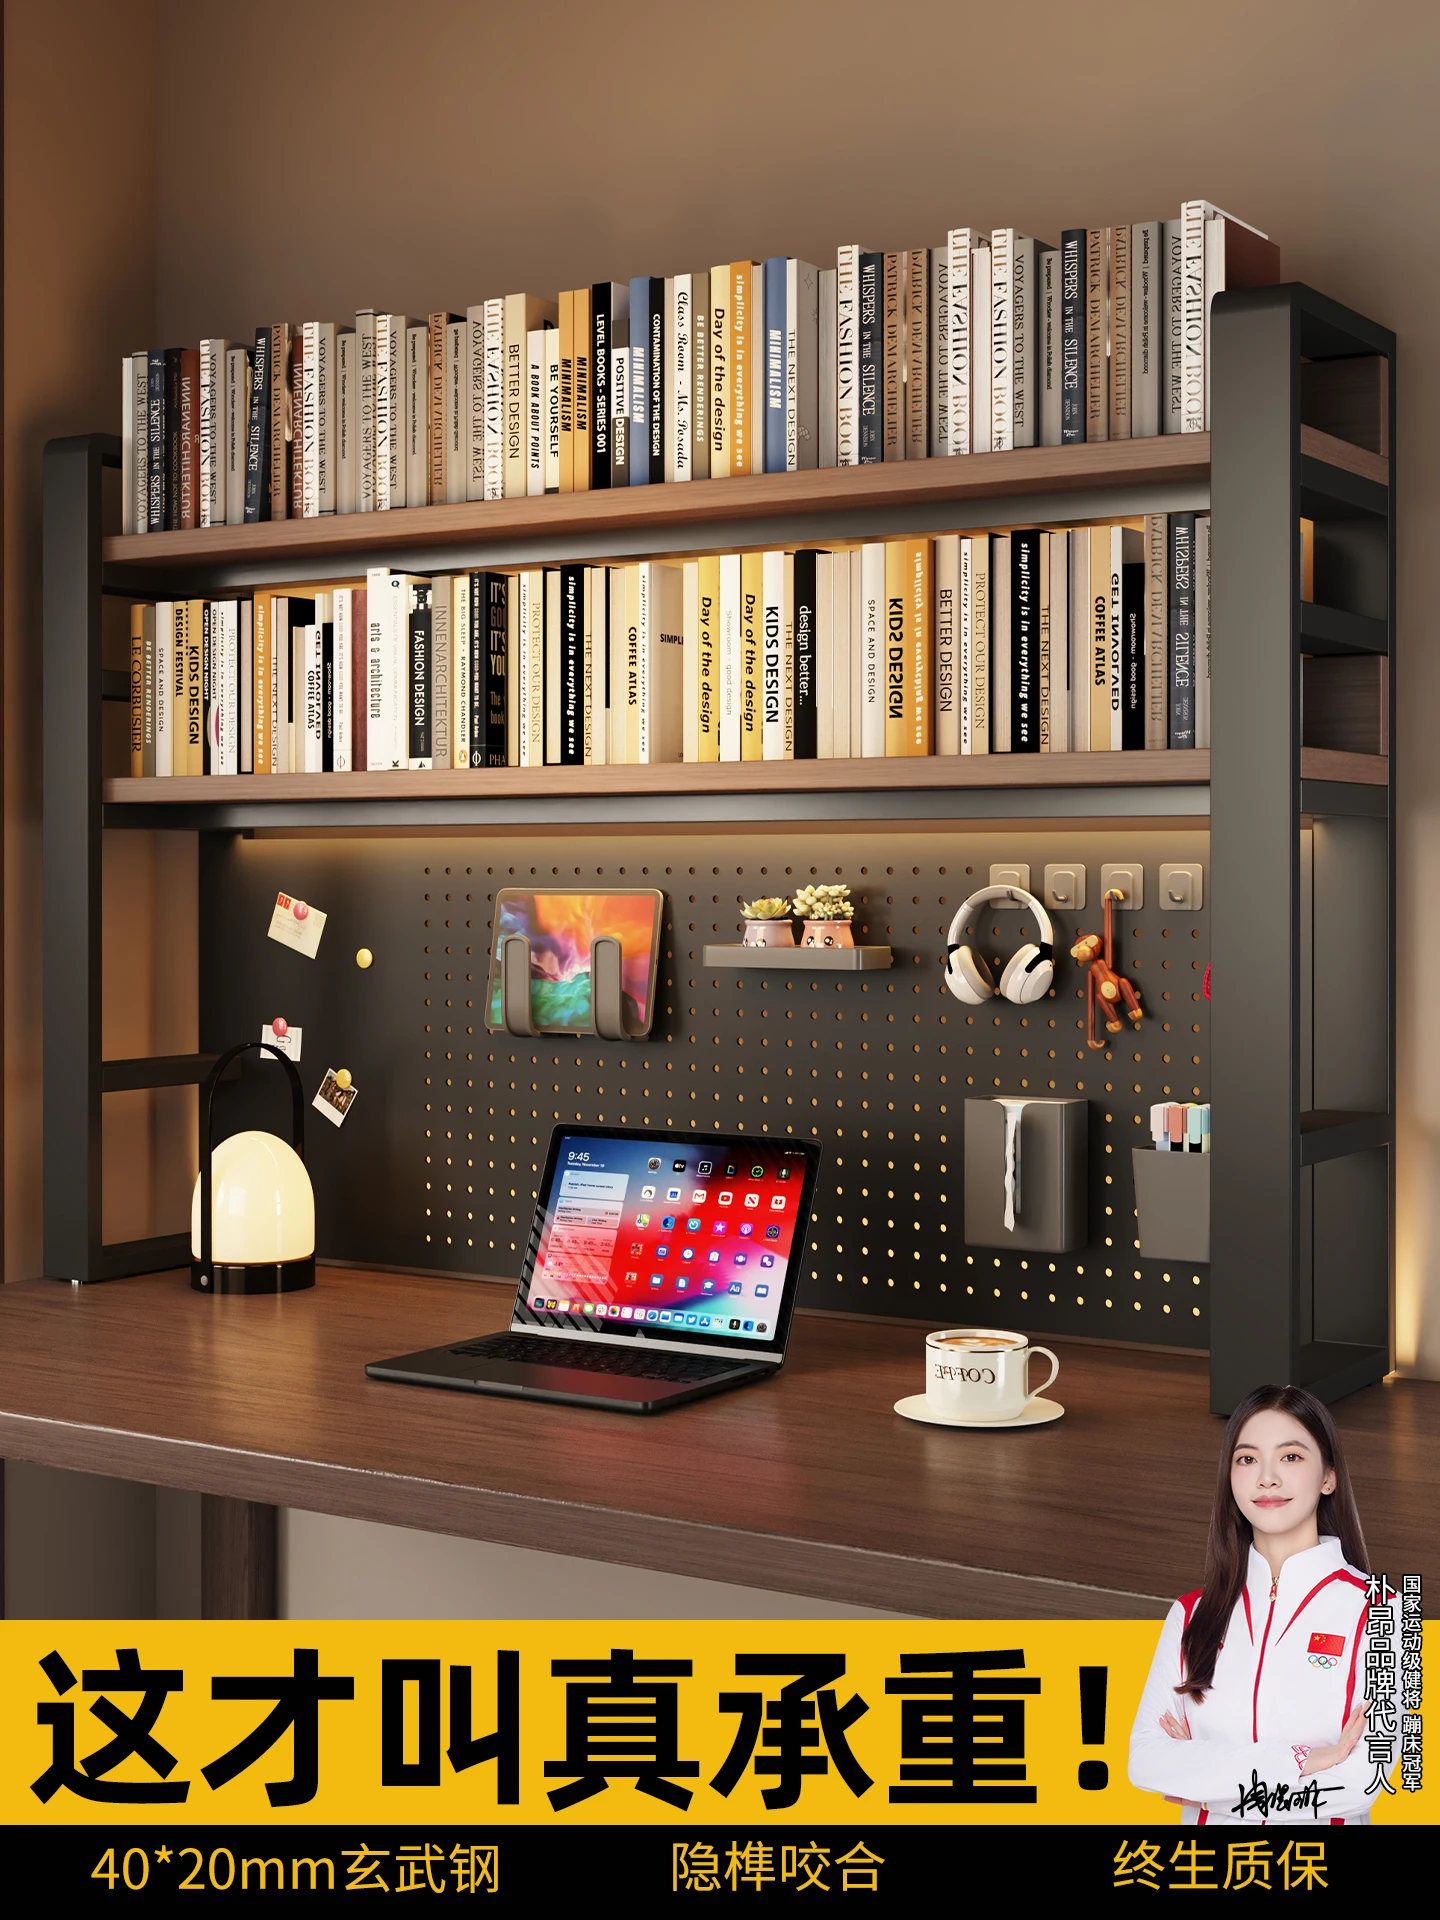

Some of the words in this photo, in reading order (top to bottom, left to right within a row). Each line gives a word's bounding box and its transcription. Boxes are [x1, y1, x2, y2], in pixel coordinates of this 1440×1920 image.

[993, 233, 1007, 276] THE
[863, 265, 875, 324] WHISPERS
[888, 255, 897, 317] PATRICK
[678, 292, 688, 327] Class
[697, 315, 704, 327] BE
[713, 309, 724, 339] Day
[993, 281, 1007, 379] FASHION
[273, 325, 281, 382] PATRICK
[678, 333, 688, 371] Room
[715, 345, 725, 361] of
[863, 331, 870, 339] IN
[509, 345, 519, 396] BETTER
[550, 365, 558, 381] BE
[597, 349, 605, 386] BOOKS
[616, 358, 624, 414] POSITIVE
[633, 347, 644, 423] MINIMALISM
[715, 366, 725, 391] the
[770, 330, 781, 408] MINIMALISM
[888, 325, 897, 445] DEMARCHELIER
[137, 374, 146, 406] WEST
[561, 359, 571, 431] MINIMALISM
[577, 357, 587, 430] MINIMALISM
[653, 390, 660, 402] OF
[863, 365, 875, 415] SILENCE
[137, 411, 146, 434] THE
[151, 399, 160, 441] SILENCE
[509, 402, 519, 458] DESIGN
[531, 403, 539, 431] ABOUT
[550, 386, 558, 457] YOURSELF
[597, 395, 606, 431] SERIES
[713, 398, 725, 450] design
[137, 438, 146, 454] TO
[272, 387, 281, 497] DEMARCHELIER
[531, 436, 539, 468] POINTS
[597, 434, 605, 452] 001
[616, 419, 624, 464] DESIGN
[678, 420, 687, 468] Posada
[137, 458, 146, 522] VOYAGERS
[151, 475, 160, 524] WHISPERS
[567, 576, 576, 629] simplicity
[700, 597, 711, 626] Day
[940, 590, 952, 645] BETTER
[131, 636, 142, 656] LE
[146, 641, 151, 651] BE
[371, 623, 381, 641] arts
[569, 633, 576, 641] is
[702, 632, 712, 648] of
[766, 607, 778, 648] KIDS
[785, 621, 793, 648] THE
[797, 606, 811, 650] design
[258, 667, 264, 675] in
[415, 631, 424, 679] FASHION
[569, 646, 576, 655] in
[702, 652, 712, 676] the
[371, 659, 382, 718] architecture
[435, 606, 447, 757] INNENARCHITEKTUR
[532, 664, 540, 692] OUR
[567, 660, 576, 716] everything
[766, 654, 778, 722] DESIGN
[785, 655, 793, 692] NEXT
[800, 655, 811, 705] better...
[940, 652, 952, 711] DESIGN
[131, 659, 142, 753] CORBUSIER
[415, 684, 424, 725] DESIGN
[532, 697, 540, 742] DESIGN
[700, 682, 712, 733] design
[785, 697, 793, 752] DESIGN
[258, 733, 263, 745] we
[569, 720, 574, 733] we
[568, 1151, 590, 1162] 9:45
